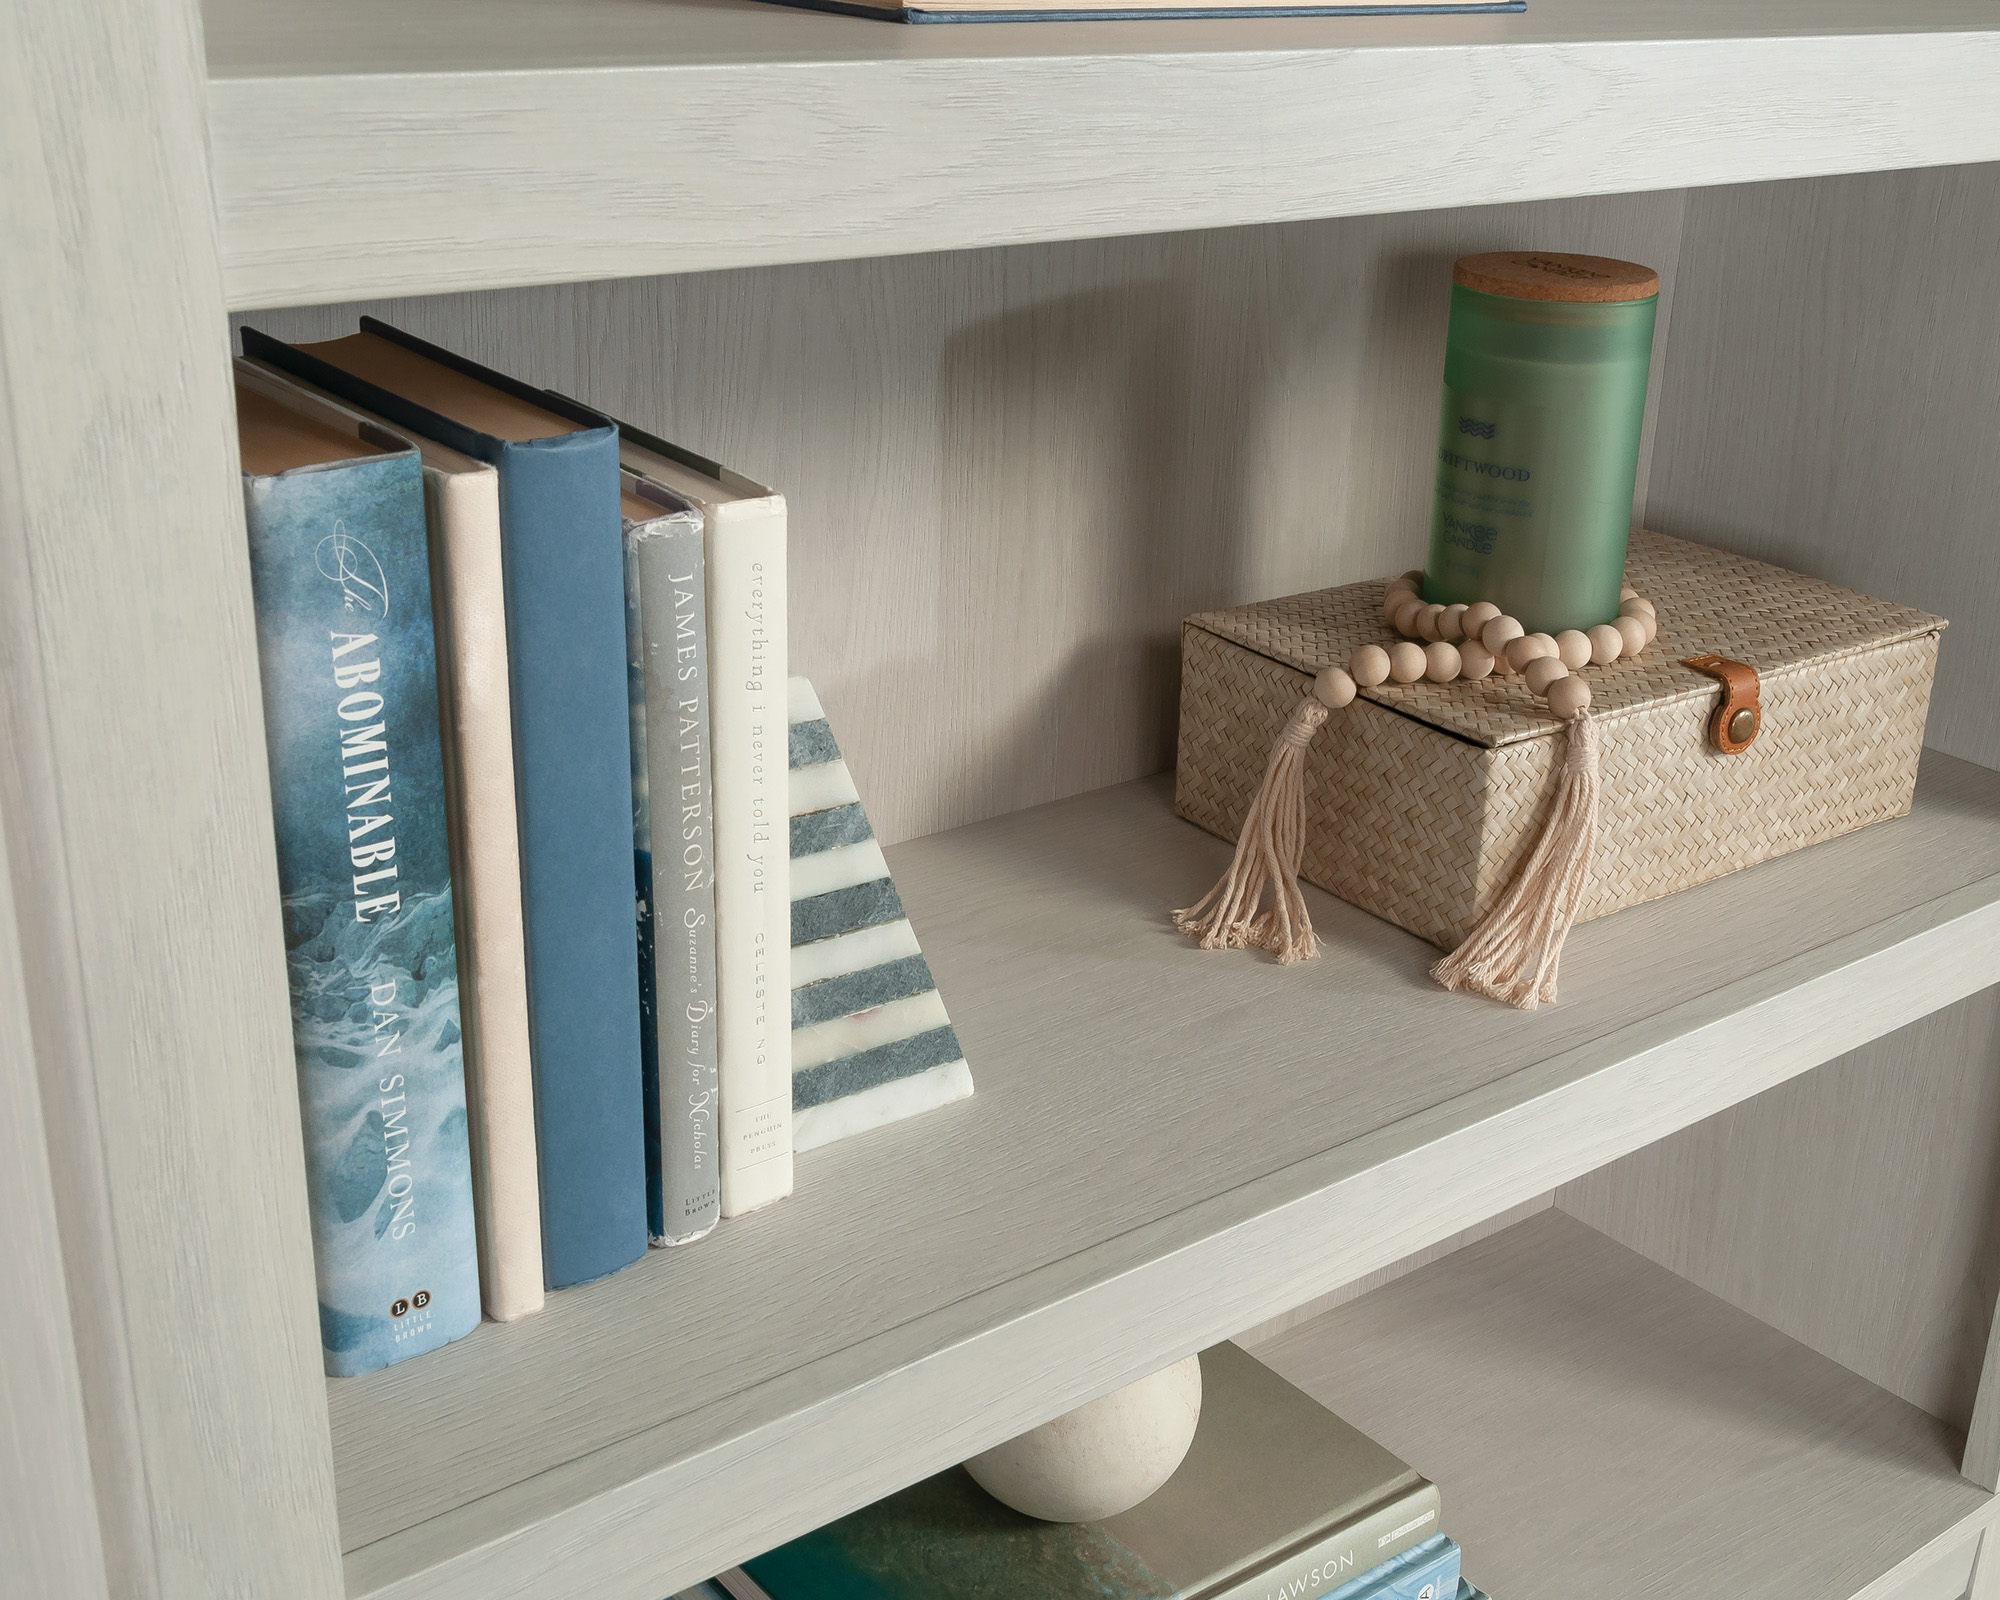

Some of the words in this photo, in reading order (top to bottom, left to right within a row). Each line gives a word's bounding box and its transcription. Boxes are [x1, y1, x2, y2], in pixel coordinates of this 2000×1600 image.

[315, 518, 389, 619] The
[668, 571, 698, 682] JAMES
[744, 562, 769, 692] everything
[752, 705, 767, 713] i
[330, 629, 402, 924] ABOMINABLE
[679, 696, 704, 893] PATTERSON
[752, 725, 763, 785] never
[752, 797, 770, 844] told
[746, 853, 764, 894] you
[683, 907, 706, 995] Suzanne's
[755, 932, 765, 1026] CELESTE
[371, 978, 402, 1059] DAN
[686, 1000, 708, 1056] Diary
[756, 1038, 766, 1065] NG
[687, 1059, 706, 1086] for
[379, 1073, 417, 1242] SIMMONS
[688, 1091, 711, 1171] Nicholas
[395, 1321, 432, 1343] BROWN
